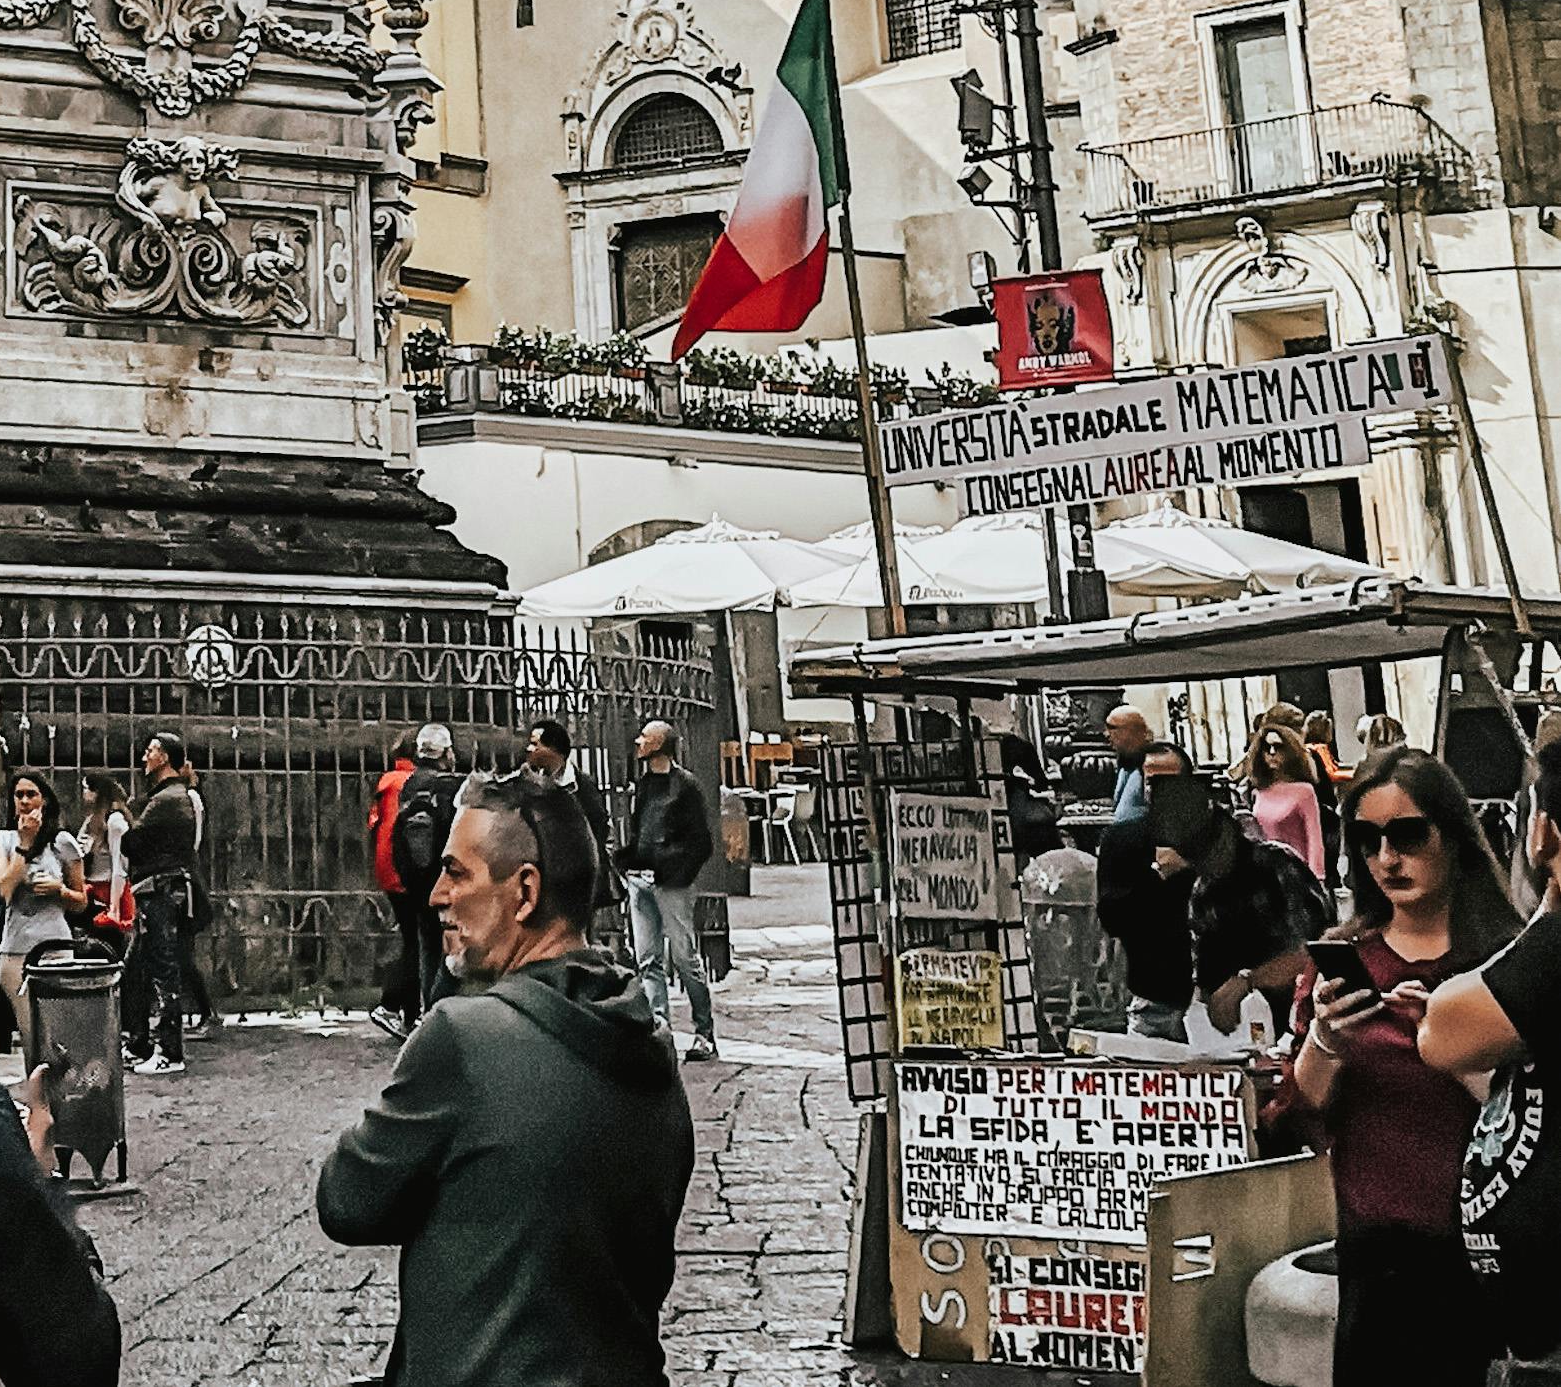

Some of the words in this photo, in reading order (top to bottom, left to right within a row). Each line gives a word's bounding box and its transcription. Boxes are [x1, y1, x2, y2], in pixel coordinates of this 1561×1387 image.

[1018, 356, 1047, 370] ANDY
[881, 402, 1031, 474] UNIVERSITÀ
[1030, 399, 1167, 448] STRADALE
[1175, 353, 1396, 433] MATEMATICA
[1217, 422, 1343, 481] MOMENTO
[898, 804, 935, 829] ECCO
[900, 832, 978, 866] MERAVIGLIA
[927, 874, 979, 911] MONDO
[902, 1066, 988, 1094] AVVISO
[997, 1066, 1046, 1094] PER
[1072, 1071, 1241, 1098] MATEMATICI
[944, 1094, 966, 1116] DI
[993, 1096, 1082, 1119] TUTTO
[1101, 1098, 1124, 1121] IL
[1140, 1099, 1239, 1124] MONDO
[919, 1114, 954, 1140] LA
[1112, 1121, 1244, 1150] APERTA
[1505, 1088, 1544, 1180] FULLY
[905, 1145, 979, 1164] CHIUNQUE
[984, 1147, 1008, 1166] HA
[1014, 1149, 1031, 1167] IL
[1036, 1151, 1127, 1171] CORAGGIO
[1137, 1153, 1155, 1170] DI
[1163, 1153, 1210, 1172] FARE
[906, 1163, 1011, 1185] TENTATIVO
[1052, 1168, 1115, 1189] FACCIA
[907, 1183, 965, 1201] ANCHE
[977, 1184, 994, 1201] IN
[1005, 1186, 1085, 1209] GRUPPO
[1097, 1189, 1147, 1210] ARM
[1031, 1207, 1043, 1223] E
[1027, 1257, 1146, 1291] CONSEG
[990, 1331, 1028, 1363] AL
[1029, 1333, 1144, 1371] MOMEN
